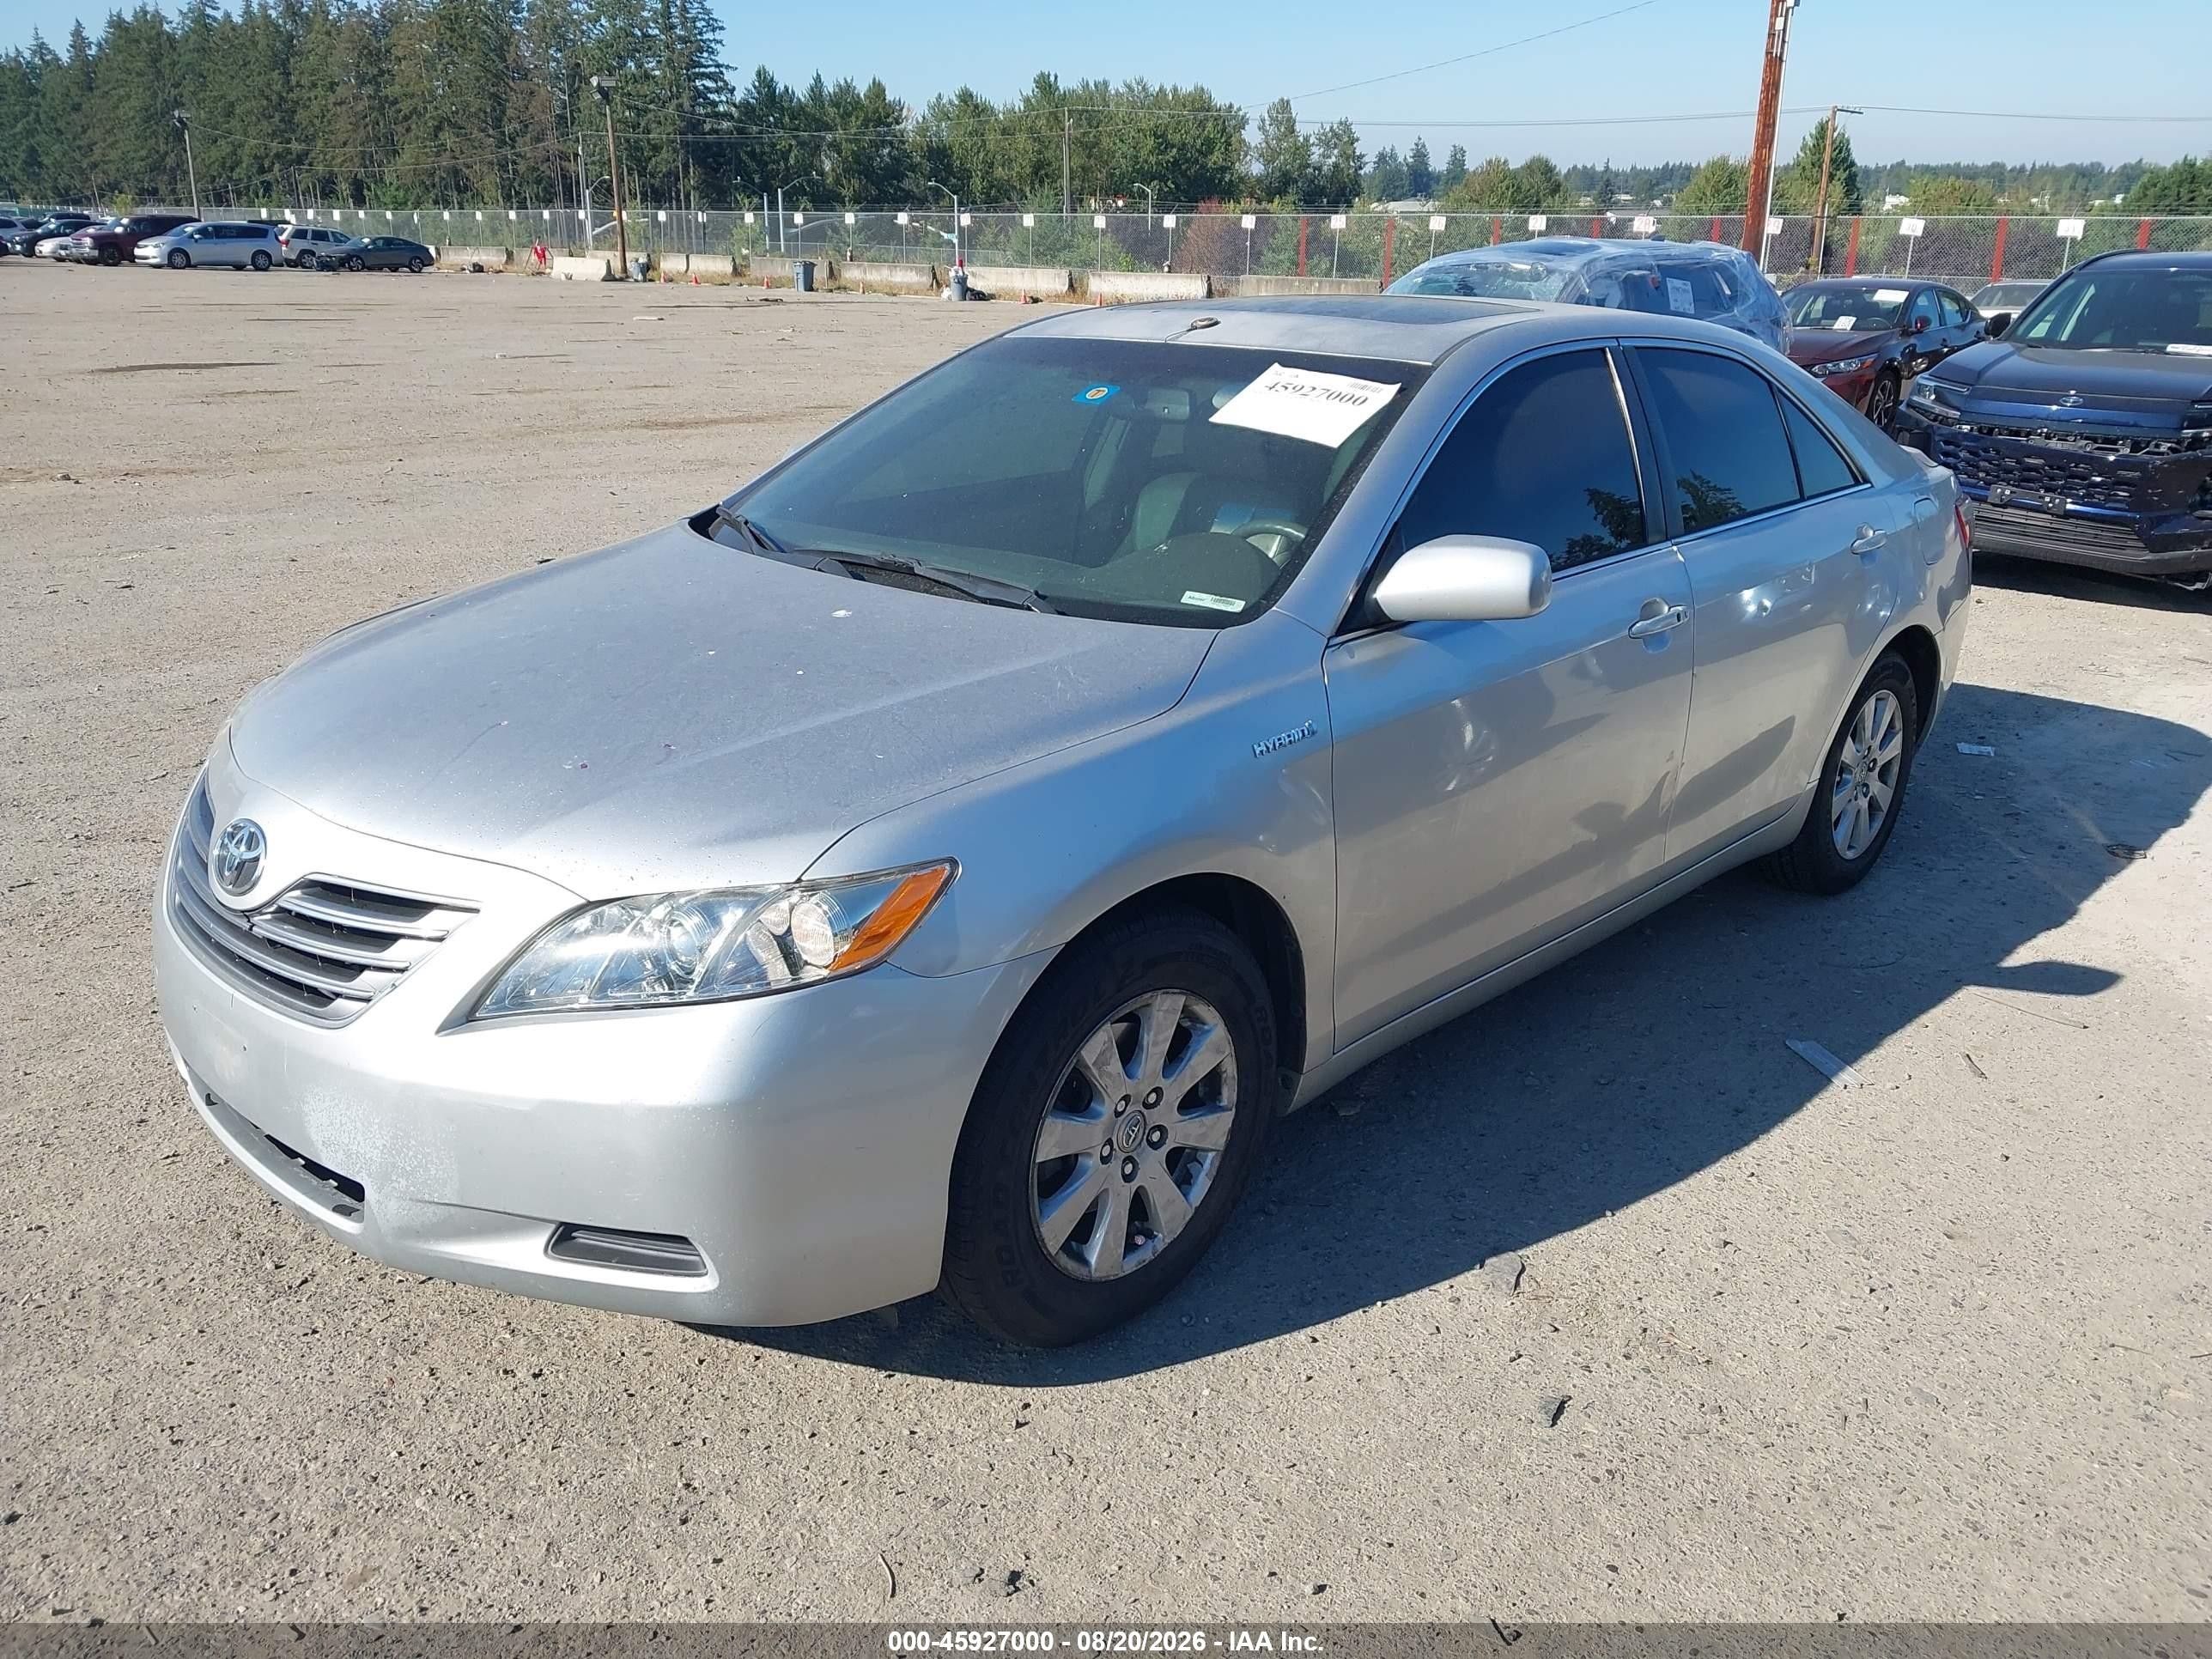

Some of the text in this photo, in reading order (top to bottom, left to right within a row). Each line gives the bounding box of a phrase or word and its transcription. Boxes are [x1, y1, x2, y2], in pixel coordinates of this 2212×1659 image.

[1531, 216, 1545, 228] 27
[1637, 217, 1650, 230] 28
[1264, 380, 1370, 406] 45927000
